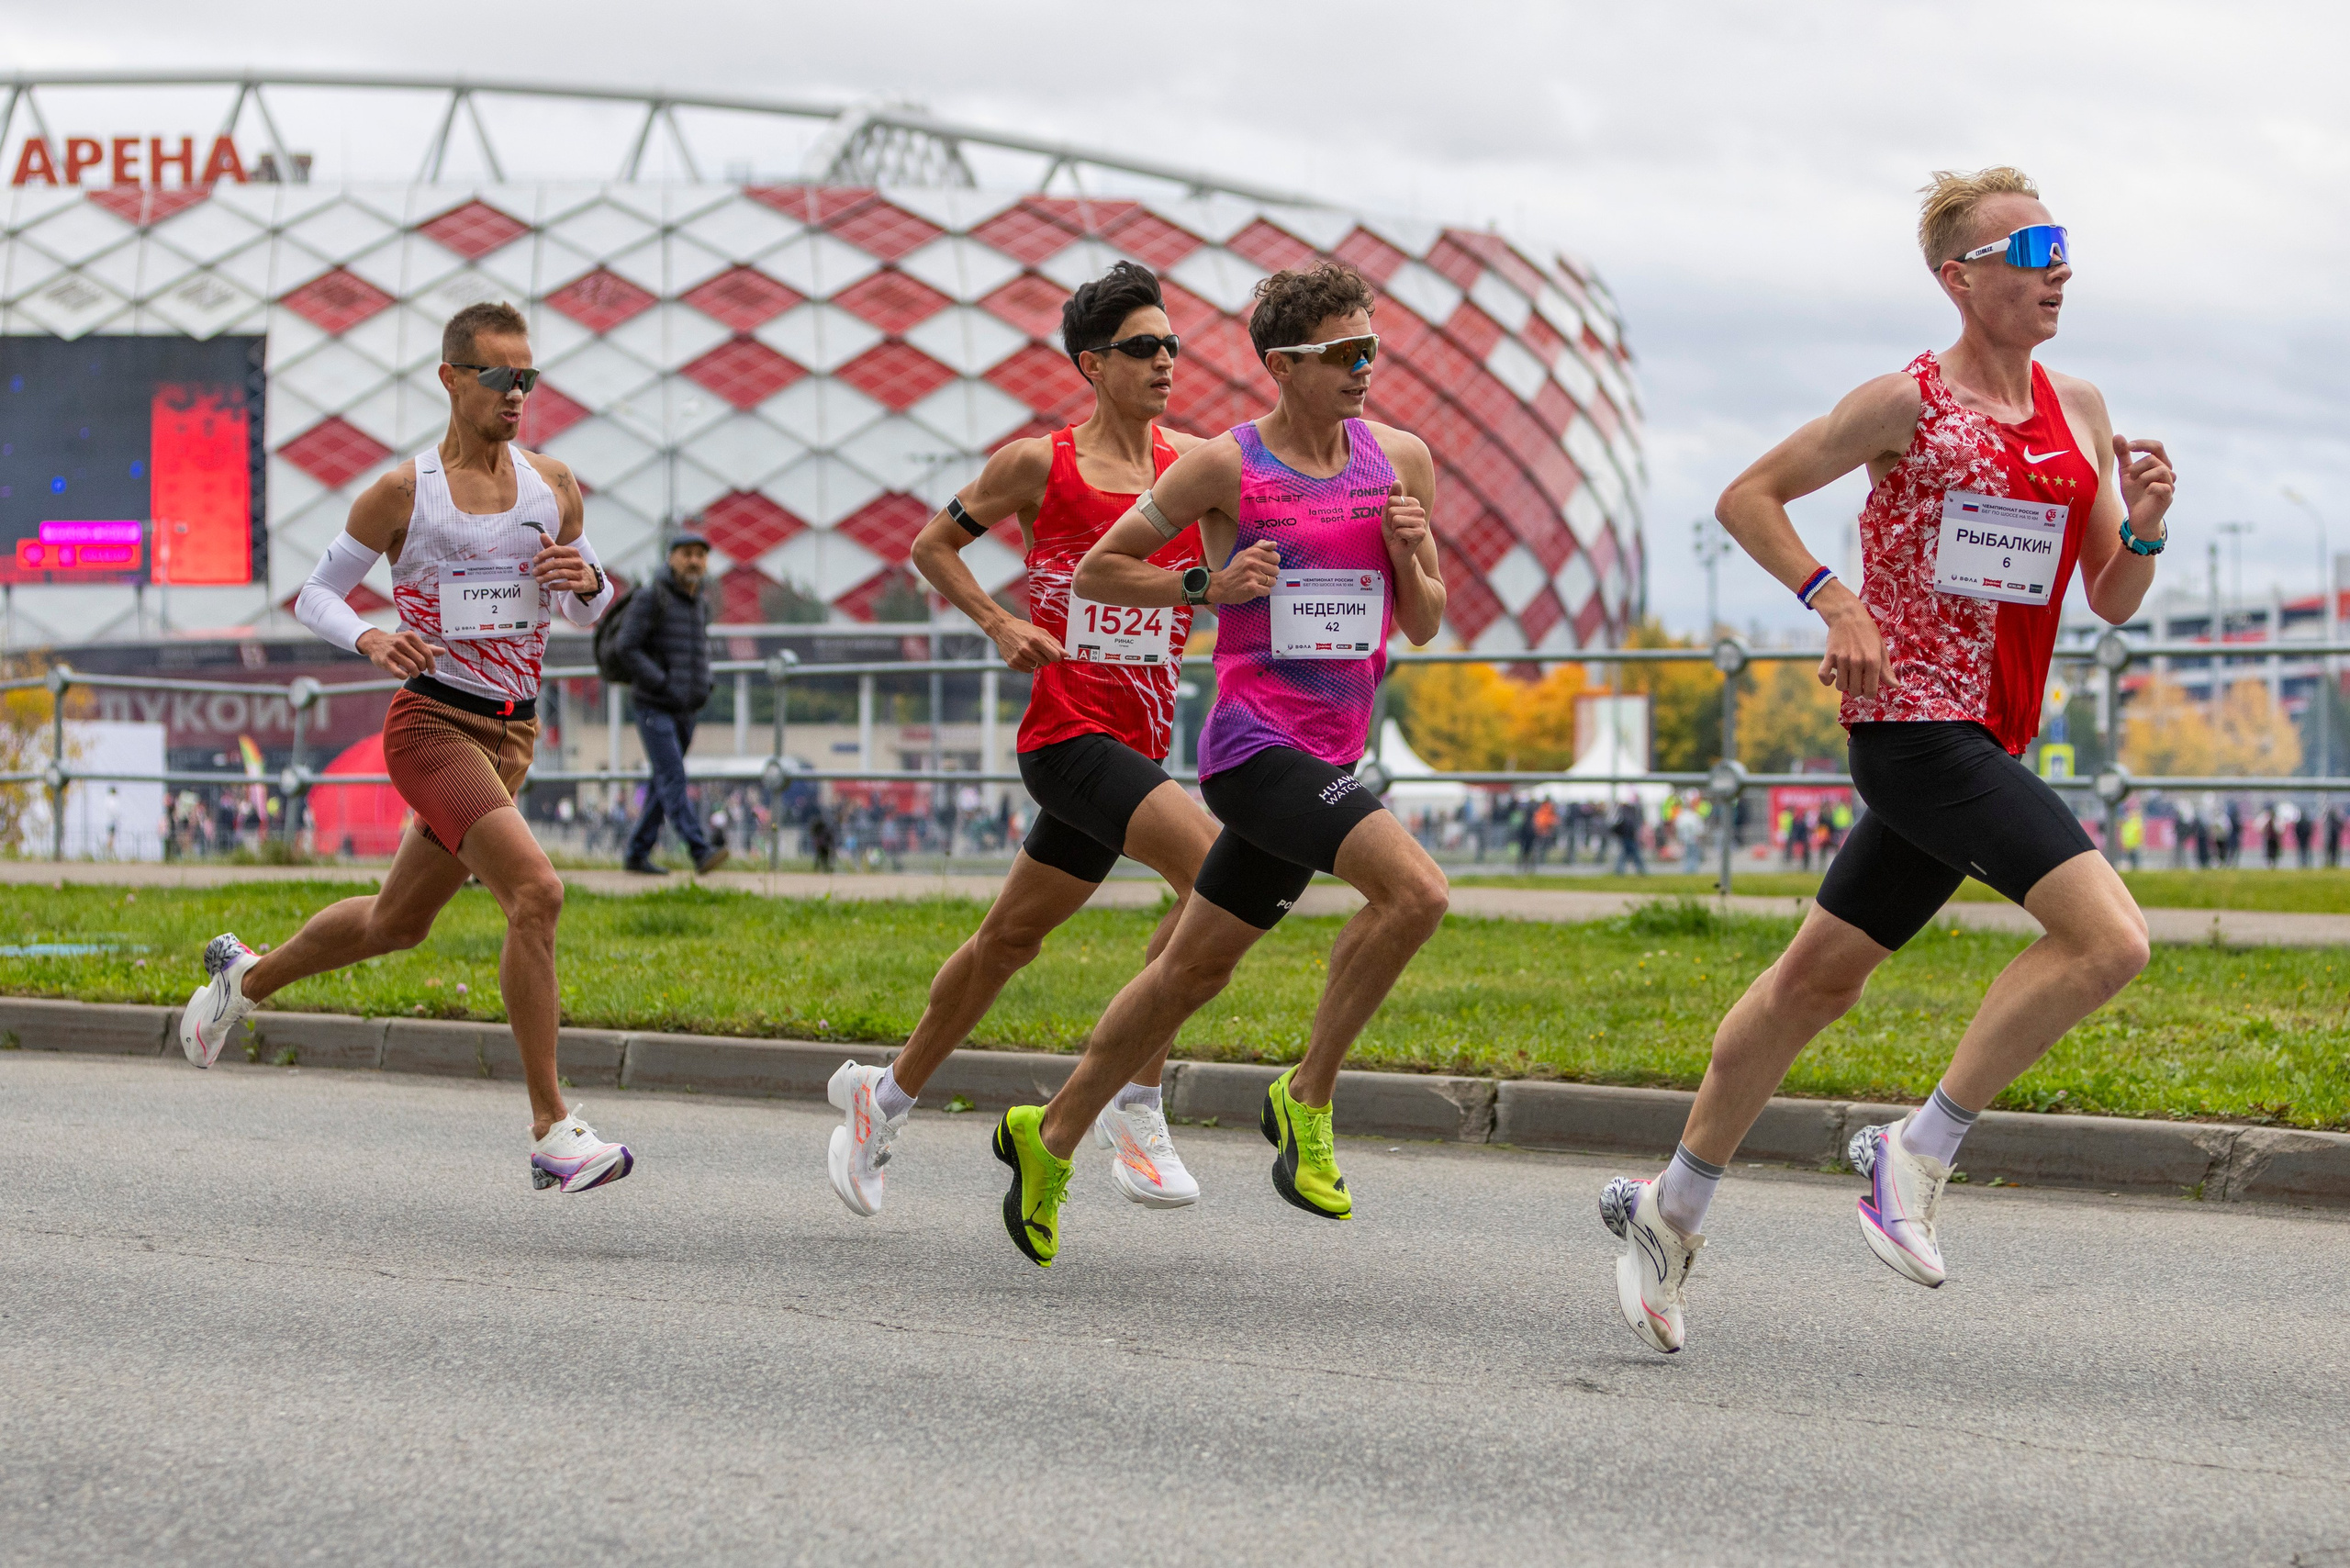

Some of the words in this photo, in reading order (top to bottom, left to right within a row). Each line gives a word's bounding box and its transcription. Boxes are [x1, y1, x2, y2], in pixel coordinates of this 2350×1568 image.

[11, 135, 249, 185] АРЕНА
[1350, 486, 1391, 498] FONBET
[1308, 507, 1344, 515] lamoda
[1982, 503, 2019, 512] ЧЕМПИОНАТ
[1320, 515, 1346, 524] sport
[1956, 528, 2053, 554] РЫБАЛКИН
[2002, 557, 2011, 568] 6
[463, 584, 521, 600] ГУРЖИЙ
[492, 605, 498, 614] 2
[1292, 602, 1366, 617] НЕДЕЛИН
[1084, 605, 1162, 636] 1524
[1325, 622, 1340, 632] 42
[1318, 775, 1355, 801] HUAW
[1326, 781, 1361, 805] WATCH
[1276, 899, 1293, 910] PO
